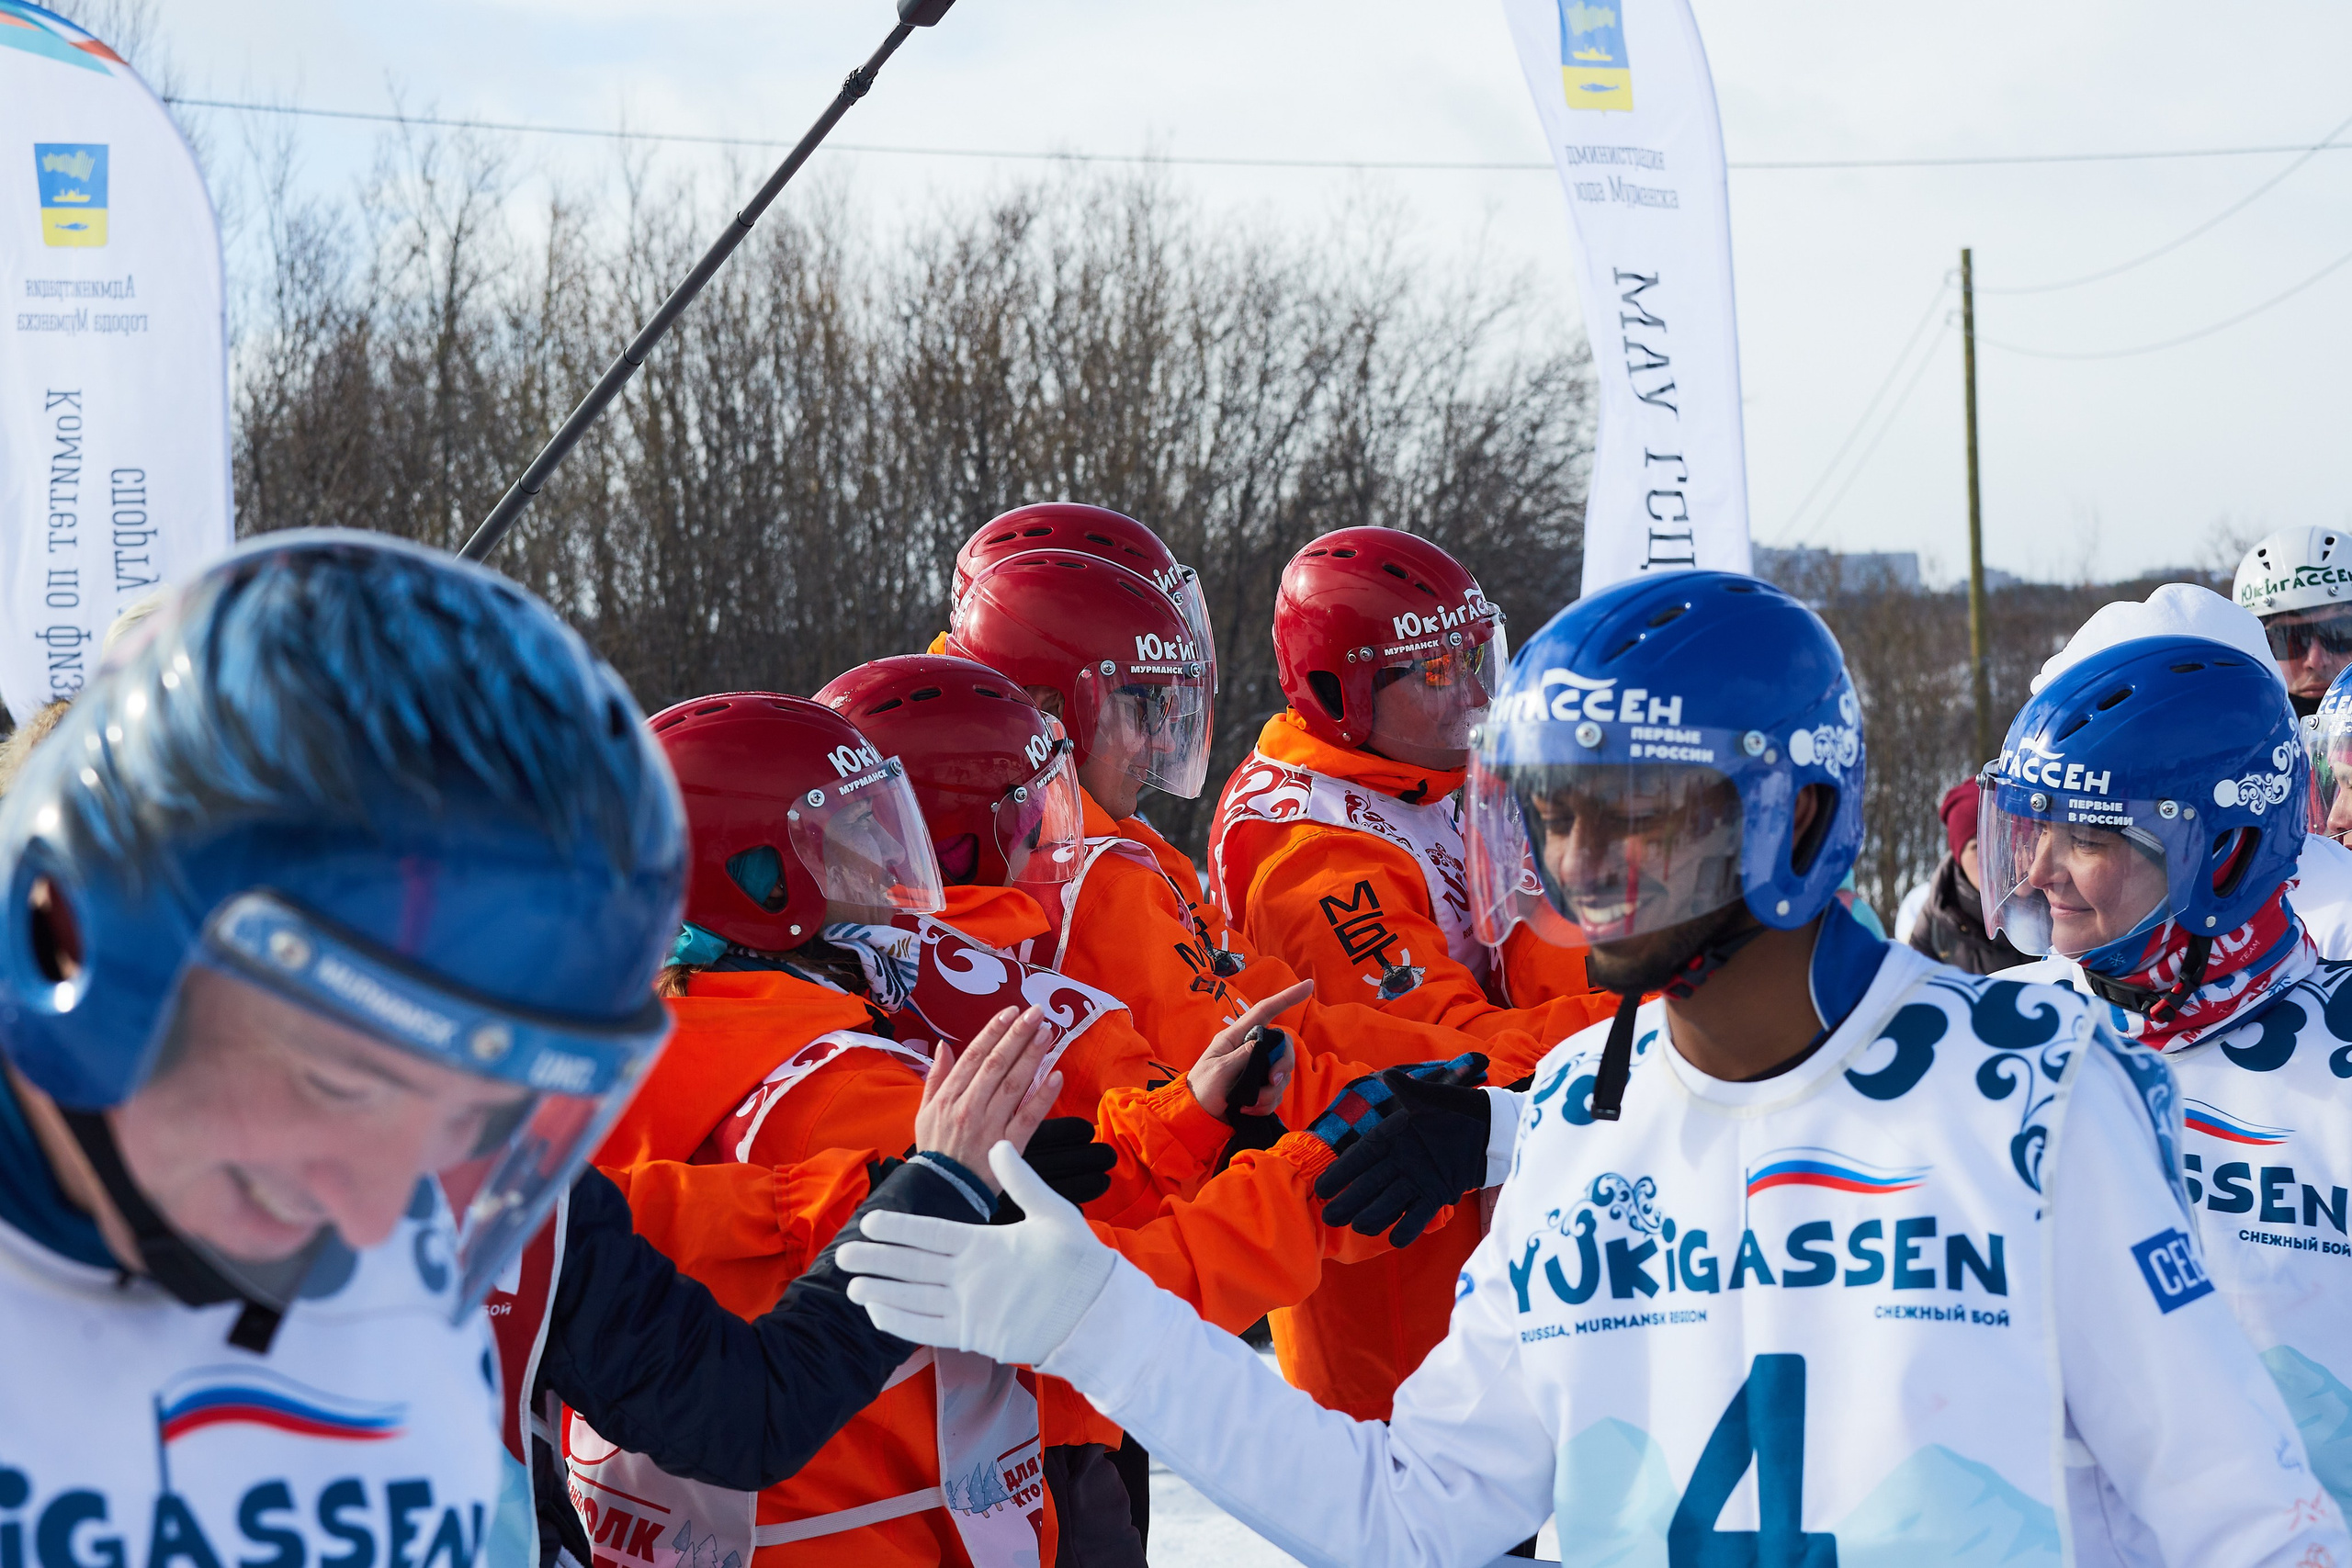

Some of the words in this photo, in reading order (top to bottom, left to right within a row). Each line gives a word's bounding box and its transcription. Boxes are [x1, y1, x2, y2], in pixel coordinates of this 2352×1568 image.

[1565, 145, 1665, 170] дминистрация
[1612, 266, 1679, 422] МАУ
[1384, 639, 1440, 657] МУРМАНСК
[1130, 665, 1183, 675] МУРМАНСК
[1630, 726, 1702, 744] ПЕРВЫЕ
[1630, 744, 1642, 758] В
[1644, 745, 1715, 763] РОССИИ
[838, 769, 888, 796] МУРМАНСК
[2068, 798, 2123, 813] ПЕРВЫЕ
[2067, 812, 2077, 822] В
[2079, 813, 2134, 827] РОССИИ
[2238, 939, 2261, 964] TEAM
[2238, 1229, 2318, 1252] СНЕЖНЫЙ
[2322, 1241, 2352, 1258] БОЙ
[1521, 1324, 1570, 1344] RUSSIA,
[1575, 1311, 1666, 1335] MURMANSK
[1874, 1304, 1966, 1323] СНЕЖНЫЙ
[1971, 1308, 2011, 1327] БОЙ
[1667, 1353, 1838, 1568] 4
[1003, 1456, 1040, 1493] ДЛЯ
[1012, 1483, 1041, 1508] КТО
[583, 1496, 666, 1563] ОЛК
